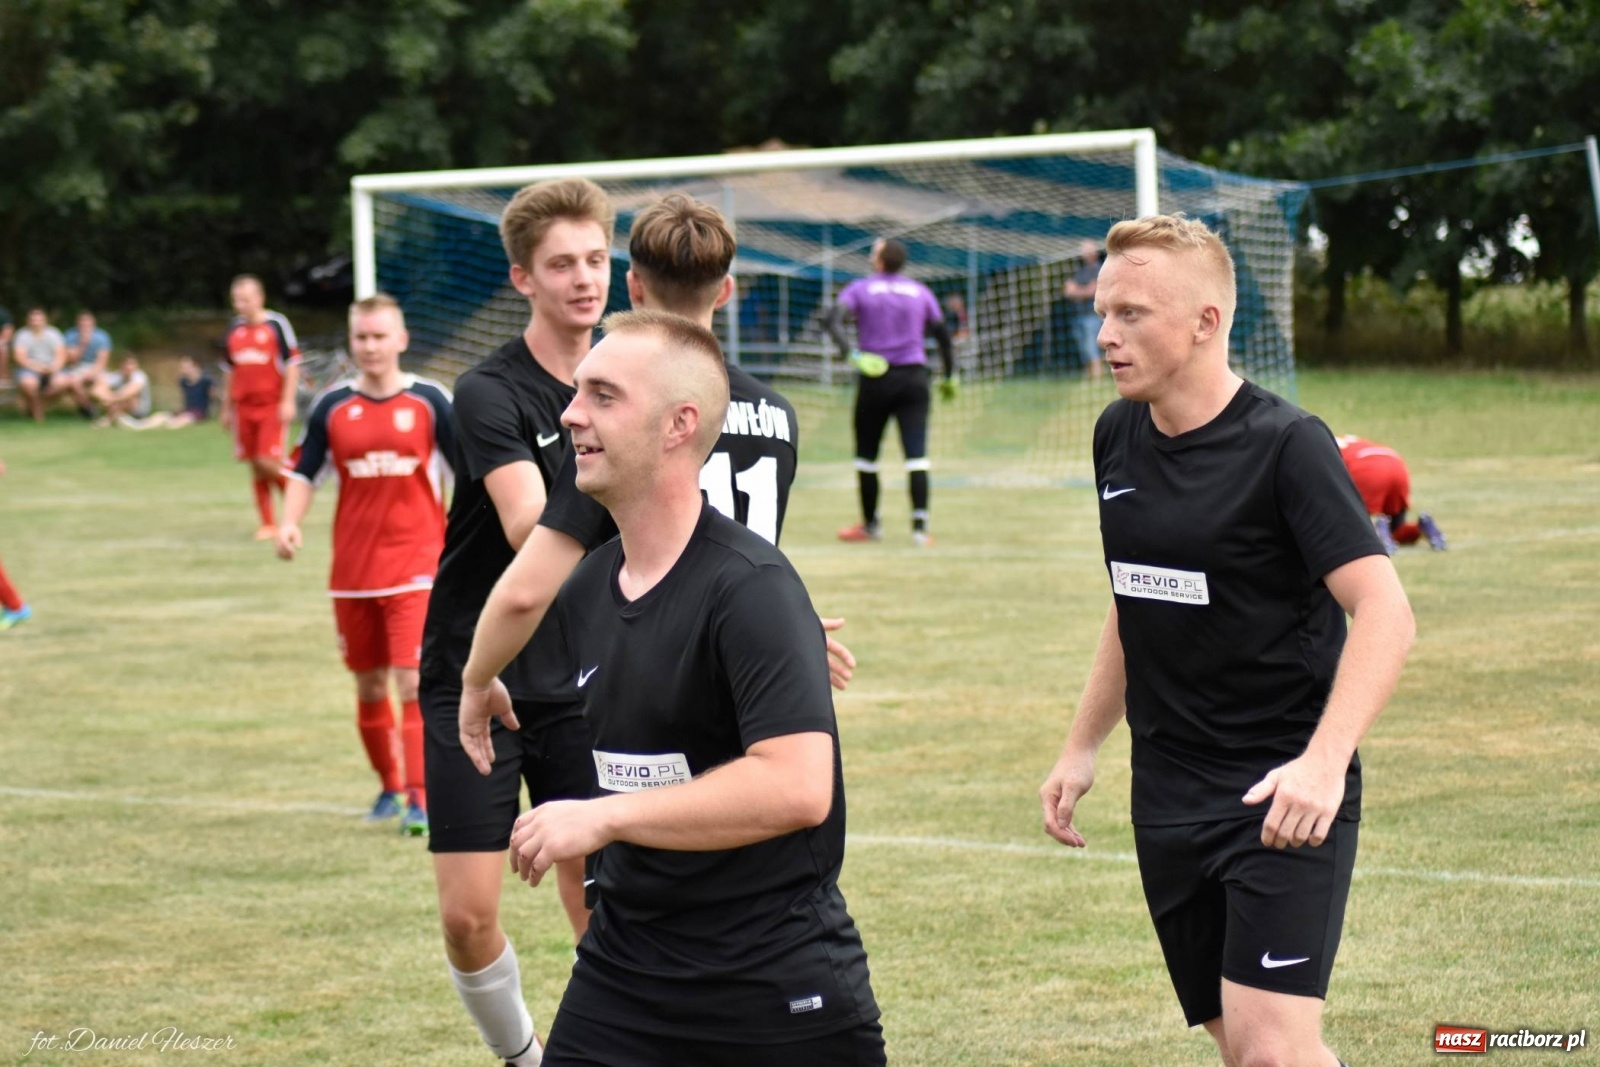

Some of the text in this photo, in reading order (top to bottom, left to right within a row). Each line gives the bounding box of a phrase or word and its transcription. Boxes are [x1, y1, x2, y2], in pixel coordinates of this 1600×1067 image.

[699, 452, 777, 546] 11
[1130, 573, 1203, 592] REVIO.PL
[1130, 586, 1203, 600] OUTDOOR SERVICE
[607, 764, 684, 778] REVIO.PL
[608, 778, 639, 787] OUTDOOR
